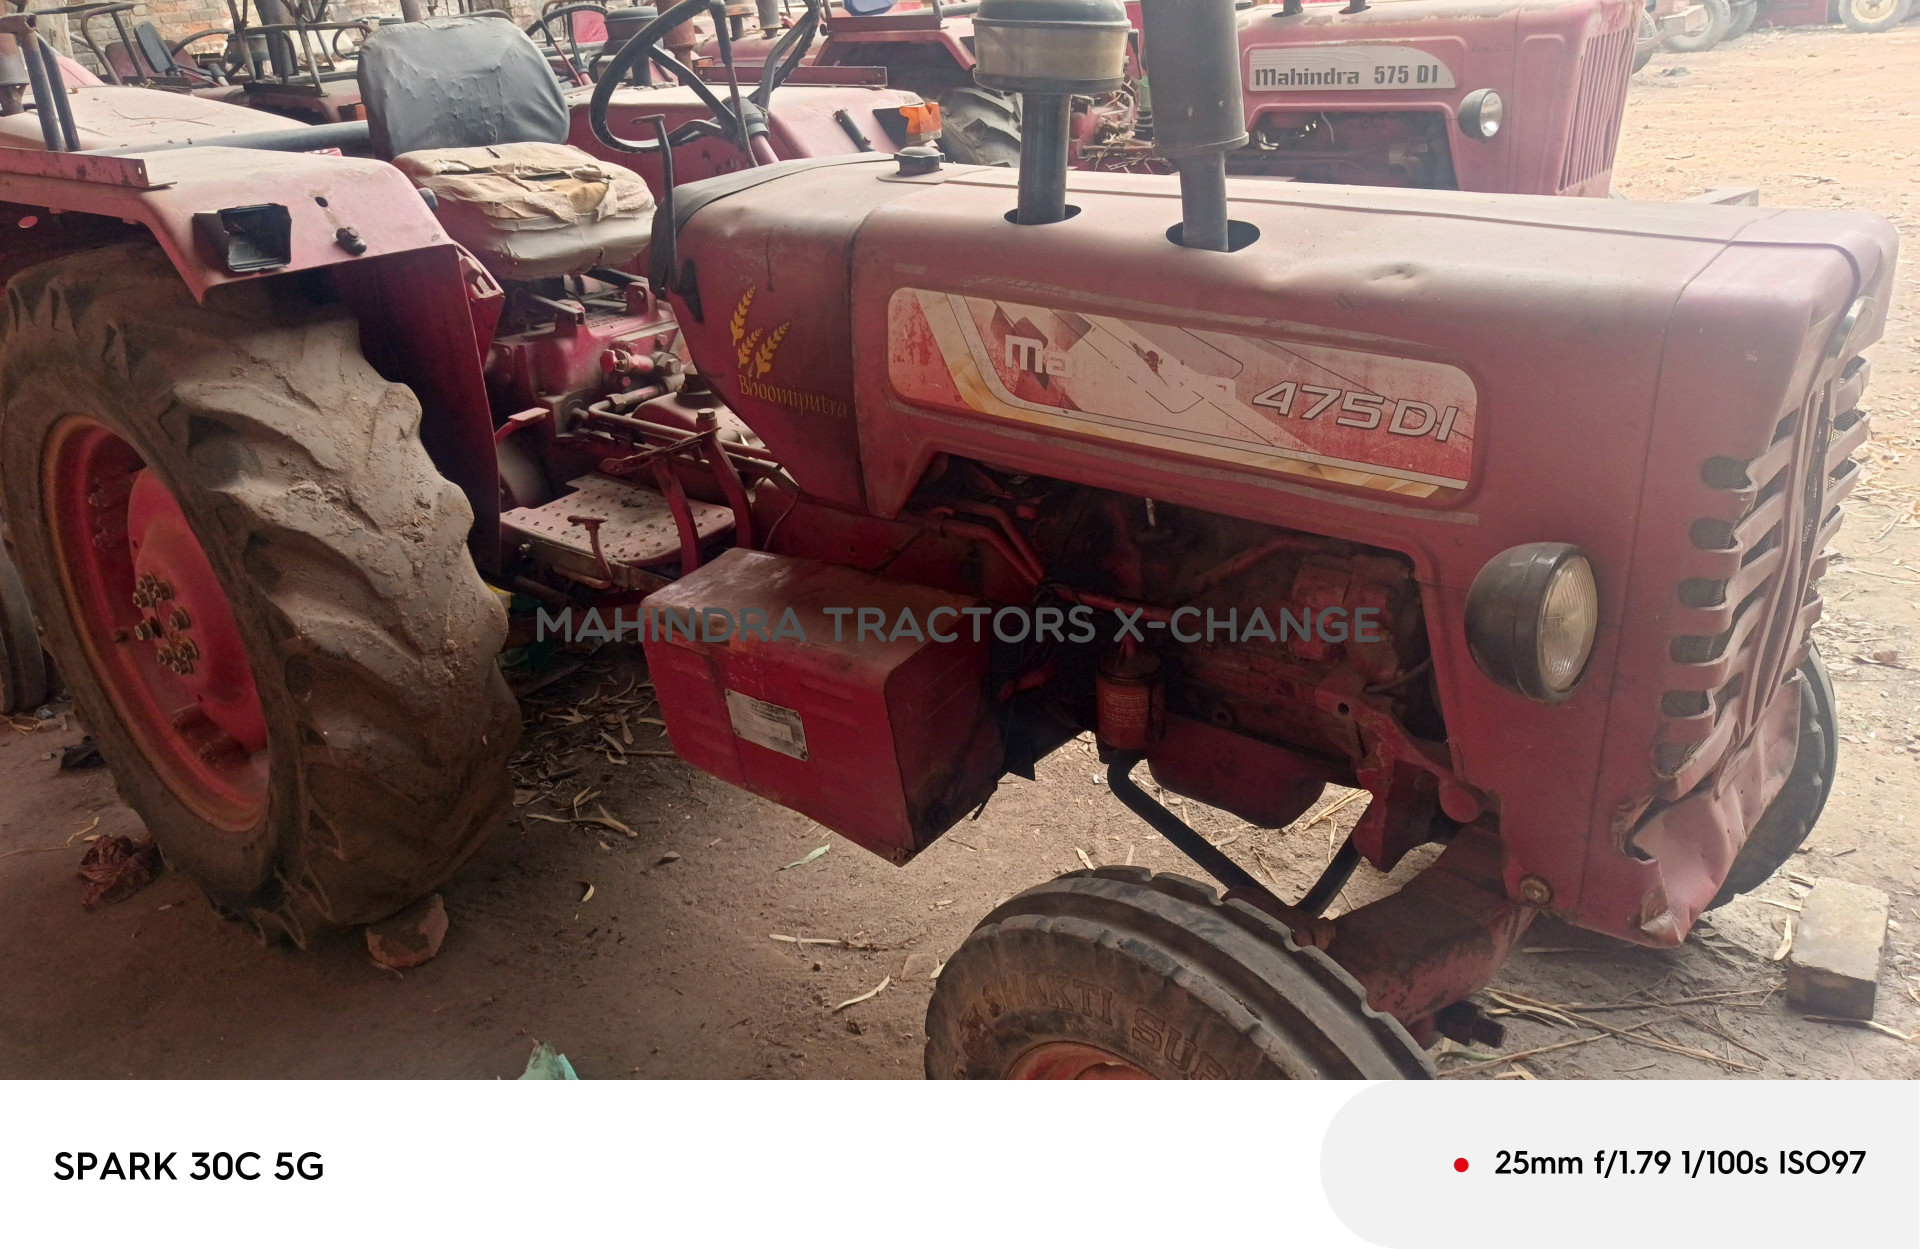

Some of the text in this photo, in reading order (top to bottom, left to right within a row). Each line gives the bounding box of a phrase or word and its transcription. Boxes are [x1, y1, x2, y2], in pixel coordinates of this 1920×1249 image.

[1255, 64, 1439, 87] Mahindra 575 DI
[737, 374, 849, 419] Bhoomiputra
[982, 972, 1113, 1026] SHAKTI
